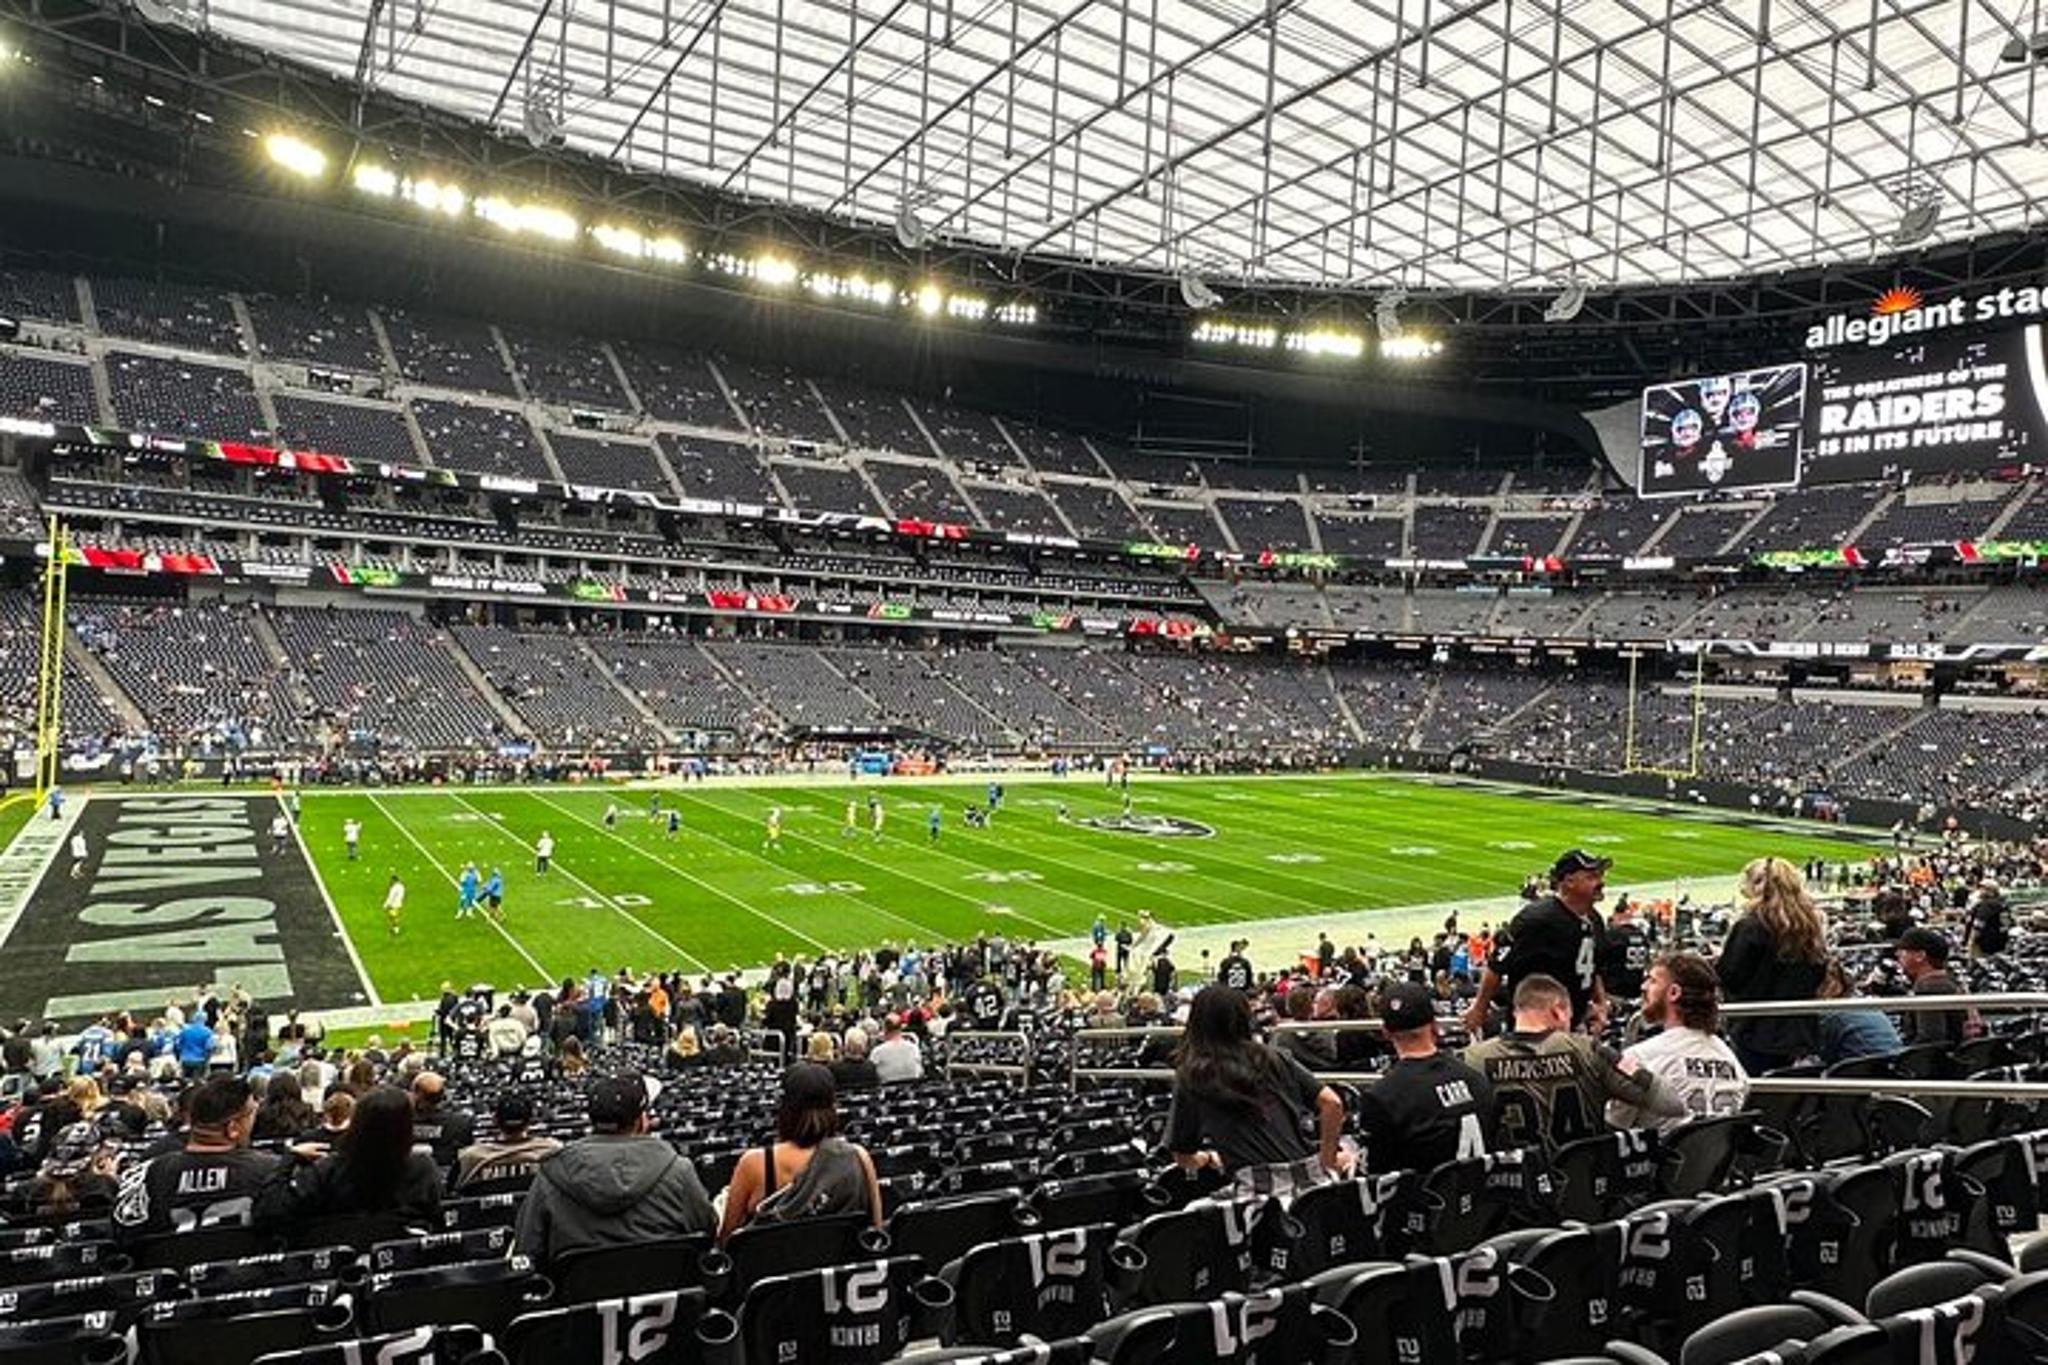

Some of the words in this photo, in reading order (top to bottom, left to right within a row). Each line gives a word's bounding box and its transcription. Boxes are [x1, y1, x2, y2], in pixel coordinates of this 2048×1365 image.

[1806, 296, 1965, 348] allegiant
[1975, 287, 2048, 320] sta
[1823, 387, 1850, 400] THE
[1973, 364, 2006, 380] THE
[1820, 384, 2005, 434] RAIDERS
[1819, 439, 1840, 455] IS
[1844, 436, 1869, 452] IN
[1874, 432, 1908, 450] ITS
[1912, 421, 2003, 447] FUTURE
[89, 798, 263, 894] VEGAS
[43, 896, 294, 1019] LAS
[1575, 937, 1597, 990] 4
[974, 994, 999, 1019] 42
[1493, 1054, 1574, 1081] JACKSON
[1436, 1080, 1474, 1107] CARR
[178, 1166, 228, 1194] ALLEN
[1022, 1227, 1087, 1288] 21
[822, 1259, 889, 1314] 21
[597, 1291, 679, 1365] 21
[830, 1322, 881, 1348] BRANCH
